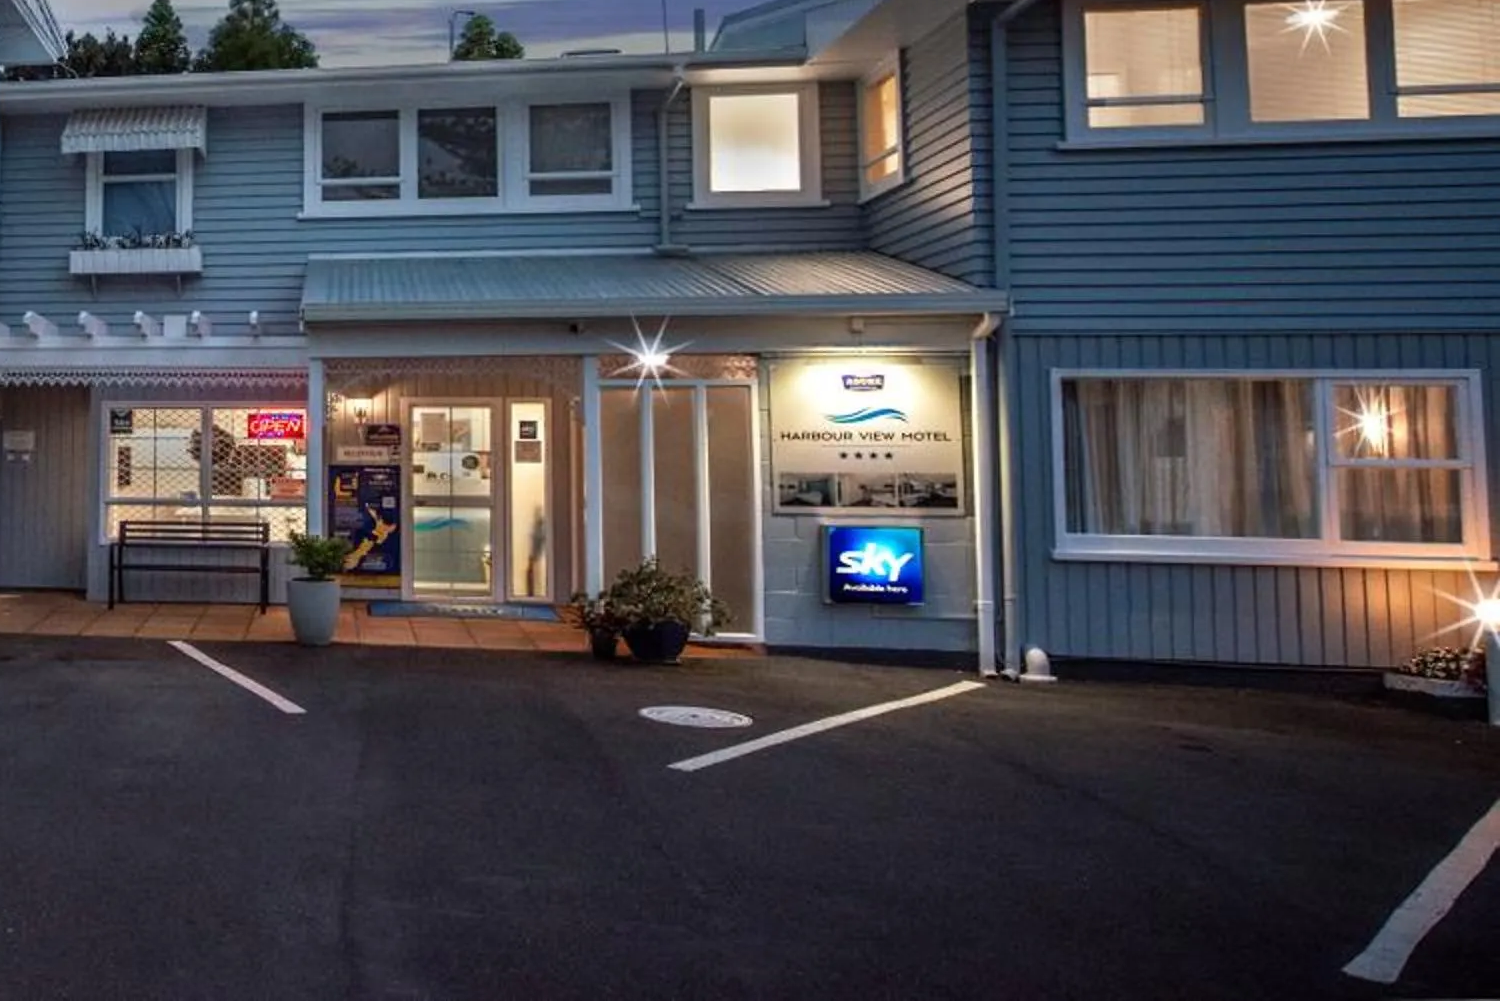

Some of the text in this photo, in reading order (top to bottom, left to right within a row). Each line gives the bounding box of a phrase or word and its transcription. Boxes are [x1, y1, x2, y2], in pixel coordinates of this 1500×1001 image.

[249, 418, 301, 434] OPEN
[781, 431, 951, 442] HARBOUR VIEW MOTEL
